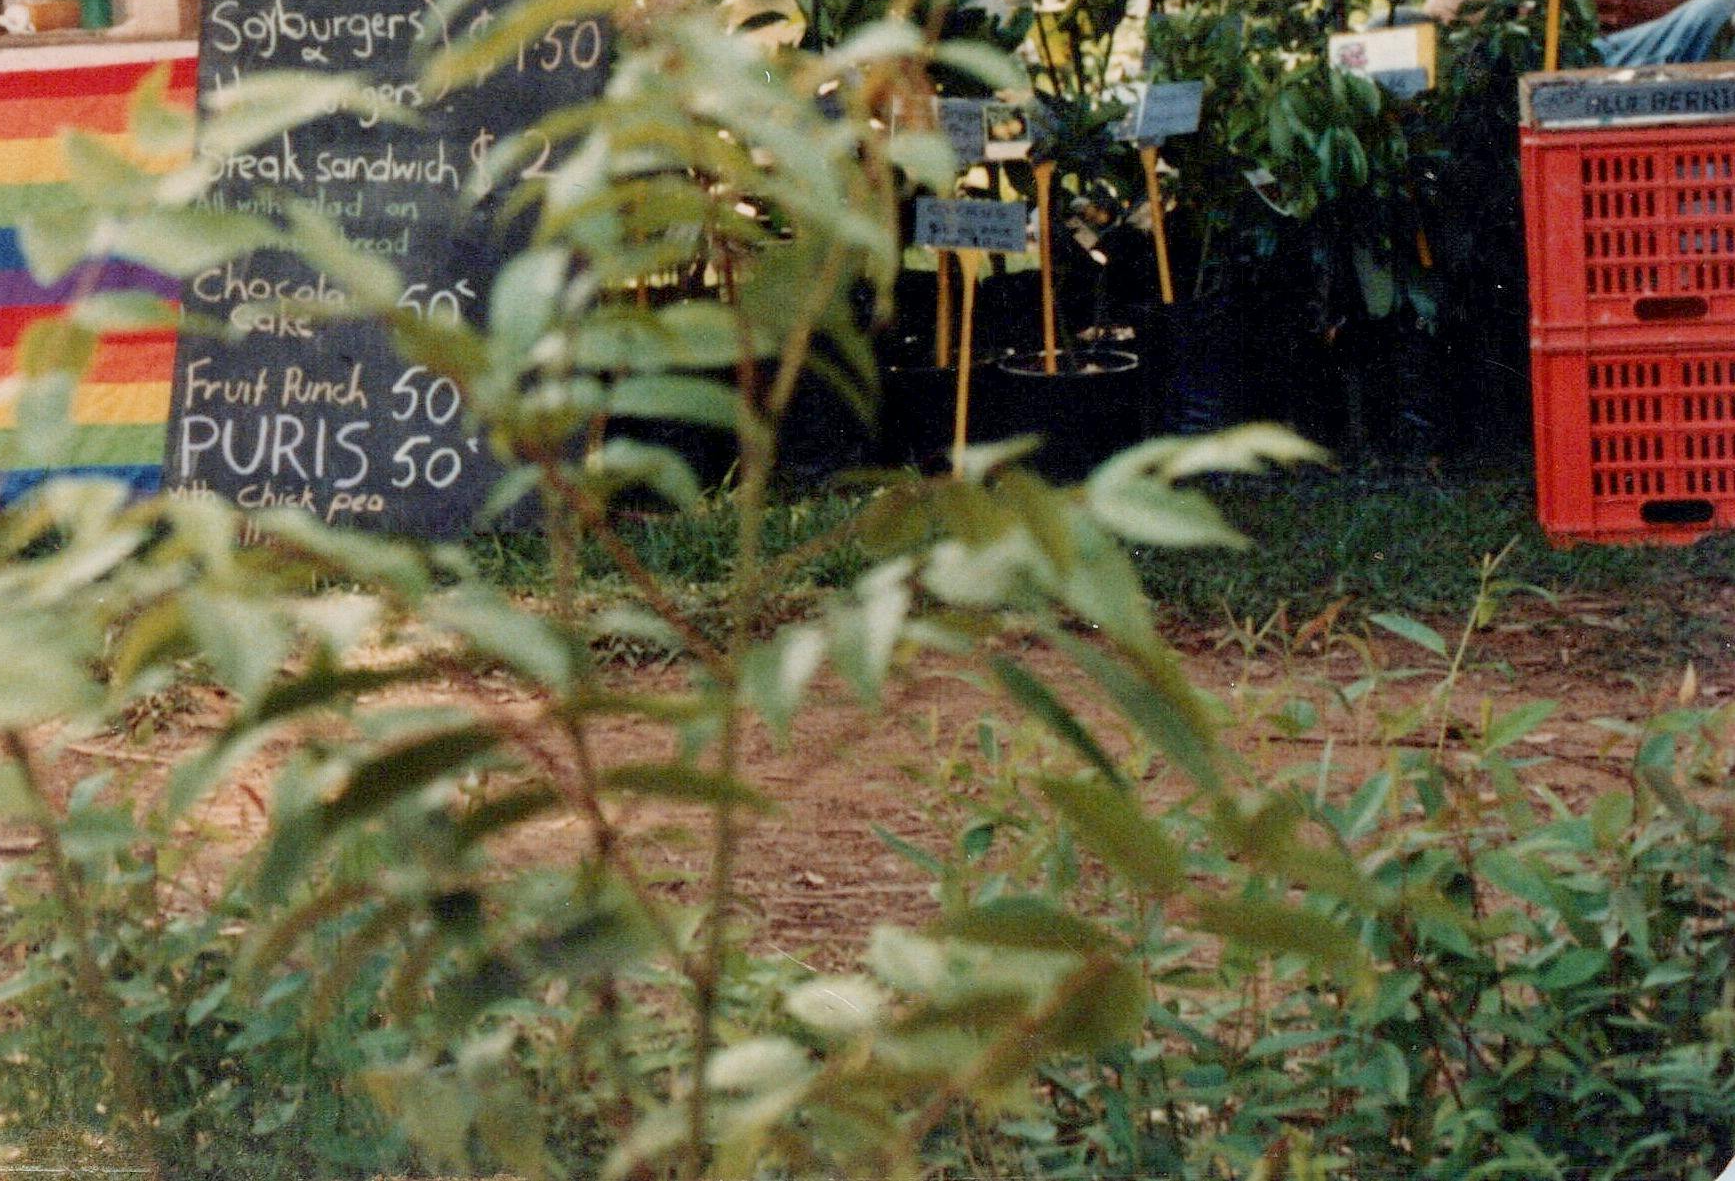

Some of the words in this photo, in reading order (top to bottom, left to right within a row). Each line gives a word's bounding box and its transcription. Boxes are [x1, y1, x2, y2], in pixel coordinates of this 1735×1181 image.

[193, 260, 346, 303] Chocola
[230, 300, 314, 338] Cake
[185, 357, 268, 408] Fruit
[281, 363, 368, 409] Punch
[180, 414, 370, 489] PURIS
[237, 481, 317, 511] Chick
[326, 491, 386, 524] pea
